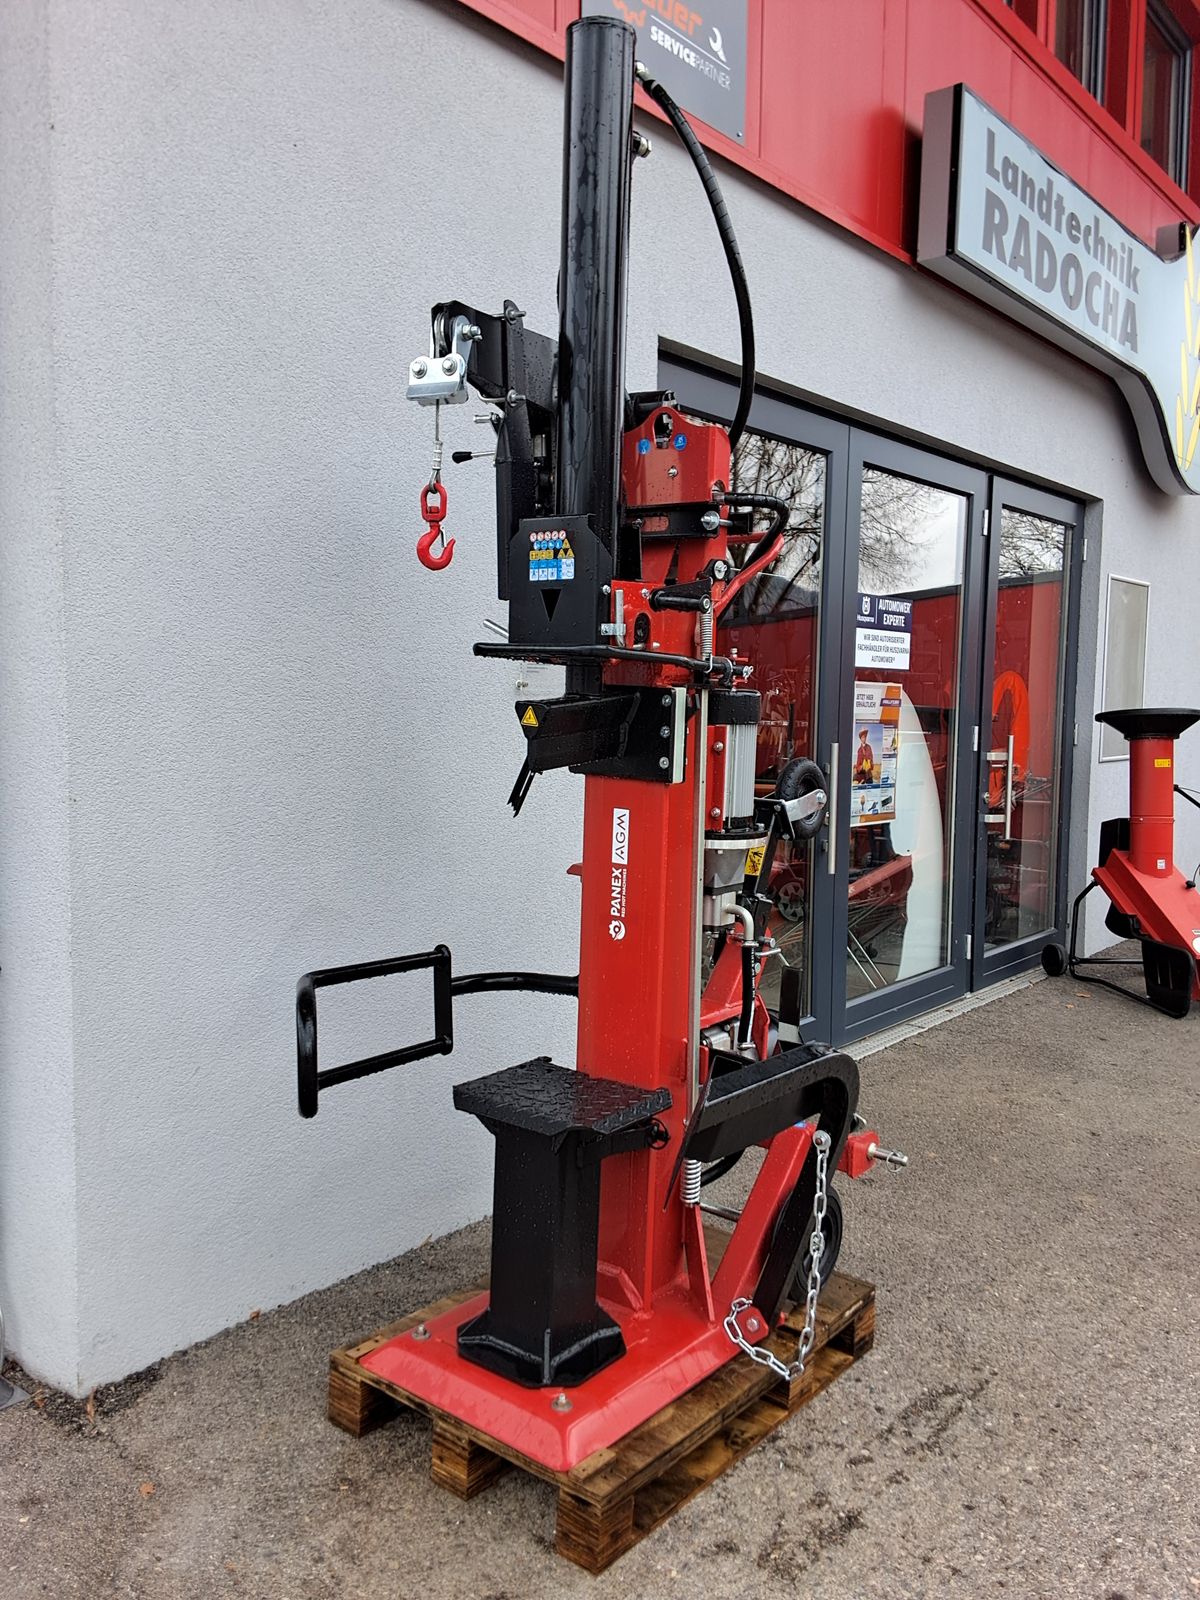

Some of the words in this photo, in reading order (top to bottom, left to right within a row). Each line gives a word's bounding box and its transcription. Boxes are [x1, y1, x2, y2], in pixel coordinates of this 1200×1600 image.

[985, 127, 1140, 295] Landtechnik
[981, 187, 1139, 354] RADOCHA
[883, 614, 905, 627] EXPERTE
[615, 813, 626, 860] AGM
[611, 867, 622, 917] PANEX
